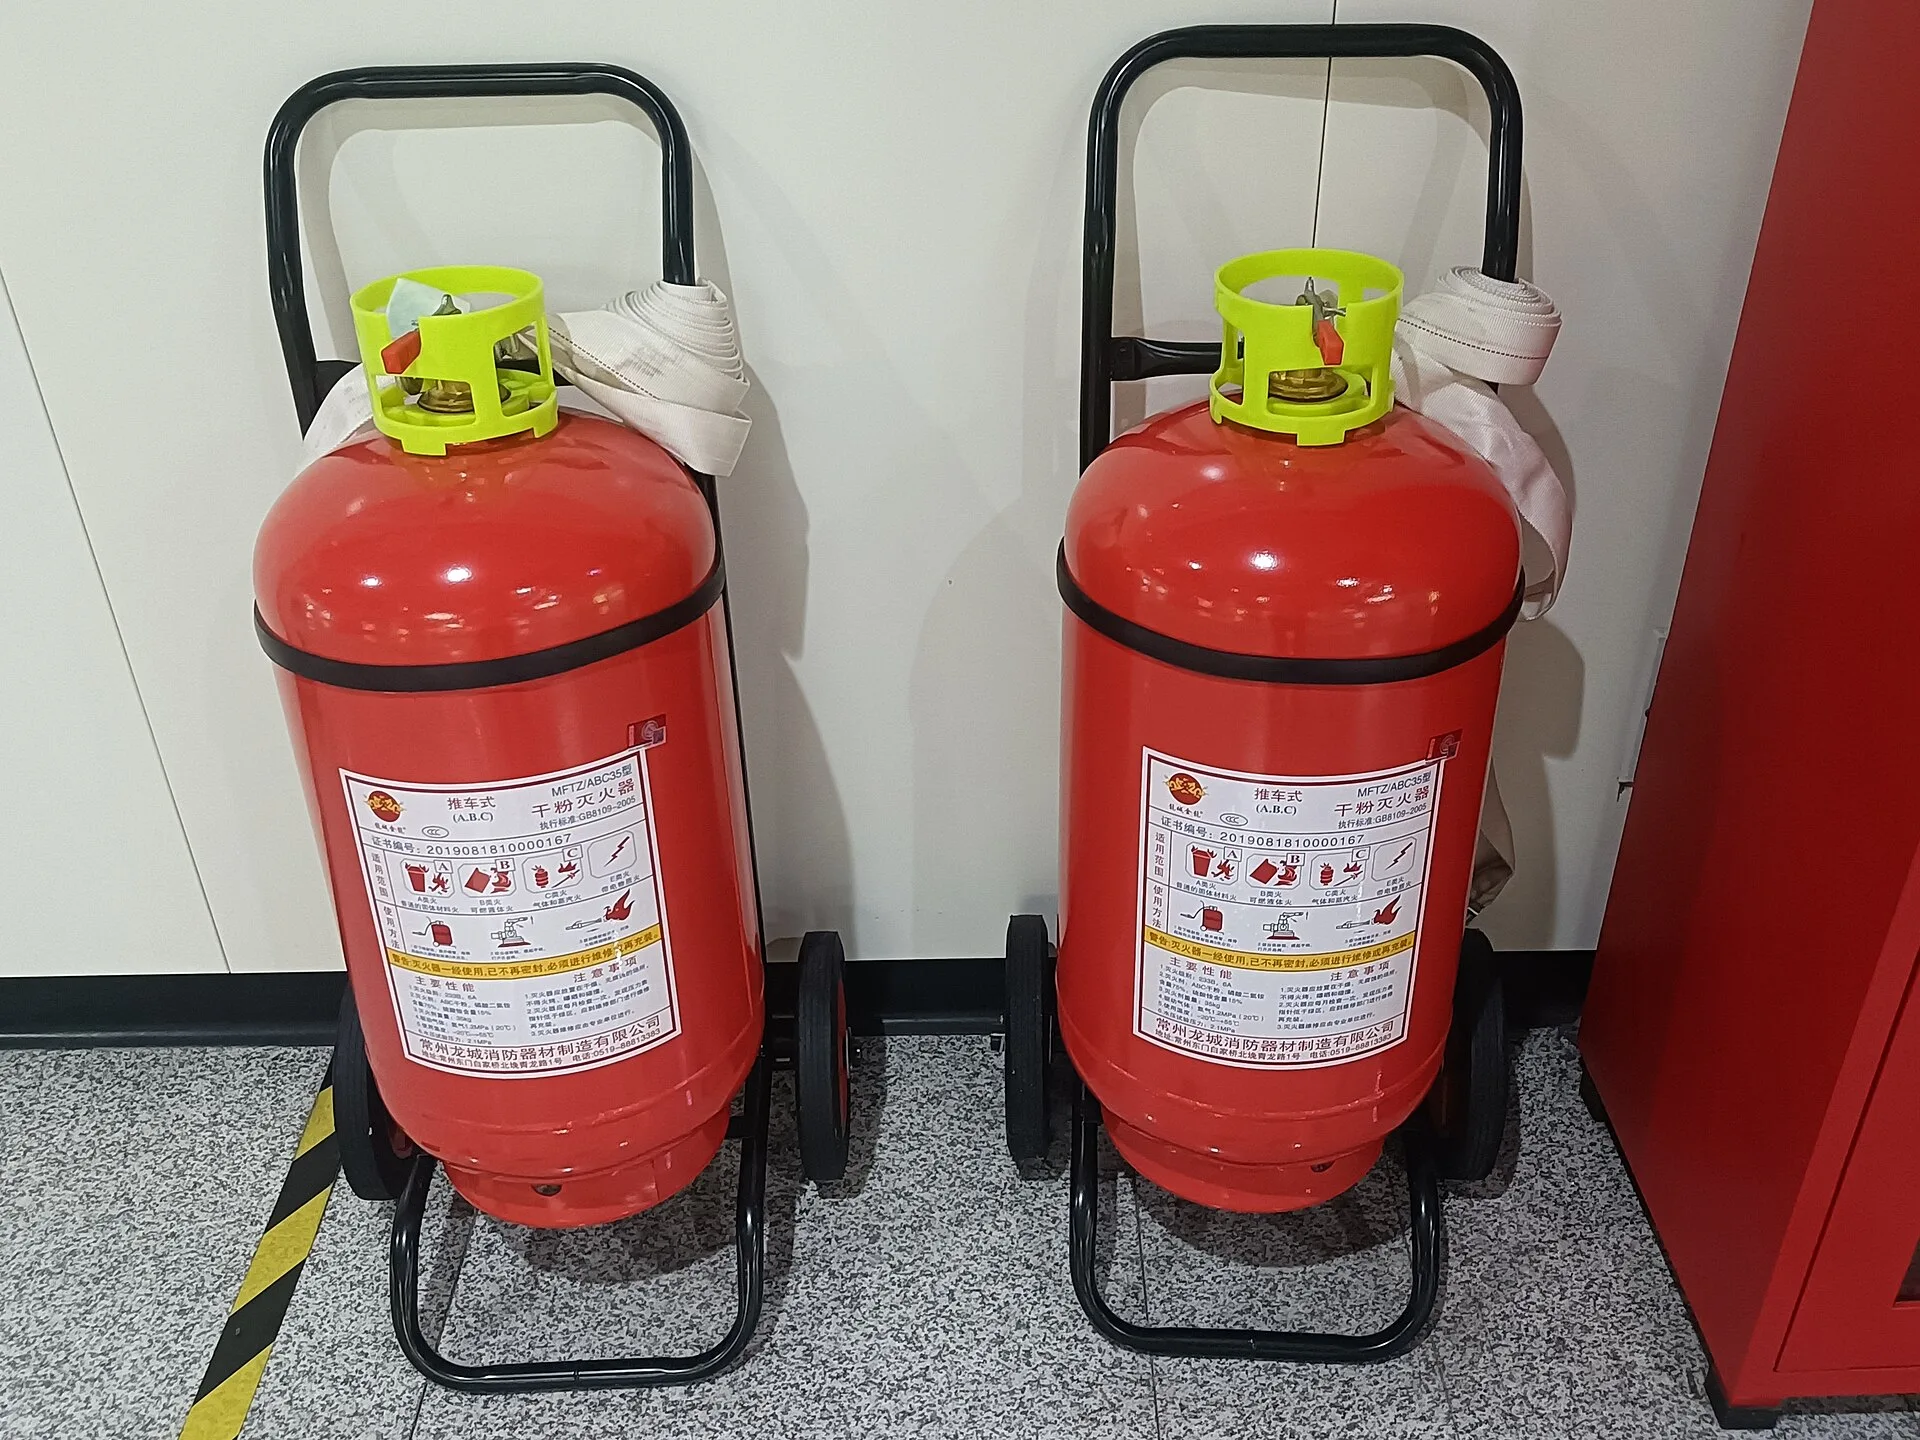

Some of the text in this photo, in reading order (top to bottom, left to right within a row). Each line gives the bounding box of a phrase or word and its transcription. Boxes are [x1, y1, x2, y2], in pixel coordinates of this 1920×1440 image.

[551, 763, 633, 797] MFTZ/ABC35型
[1357, 771, 1432, 798] MFTZ/ABC35型
[447, 796, 497, 811] 推车式
[531, 778, 635, 818] 干粉灭火器
[1254, 788, 1303, 802] 推车式
[1335, 785, 1430, 817] 干粉灭火器
[452, 812, 494, 824] (A.B.C)
[1256, 805, 1297, 816] (A.B.C)
[567, 848, 578, 858] C
[1154, 832, 1166, 877] 适用范围
[1227, 850, 1238, 859] A
[1290, 855, 1300, 864] B
[1355, 849, 1366, 859] C
[371, 853, 389, 898] 适用范围
[439, 862, 449, 871] A
[500, 860, 510, 869] B
[1152, 885, 1163, 928] 使用方法
[573, 955, 637, 983] 注意事项
[1170, 957, 1232, 979] 主要性能
[1330, 960, 1390, 982] 注意事项
[415, 976, 475, 992] 主要性能
[420, 1015, 660, 1060] 常州龙城消防器材制造有限公司
[1156, 1017, 1394, 1053] 常州龙城消防器材制造有限公司
